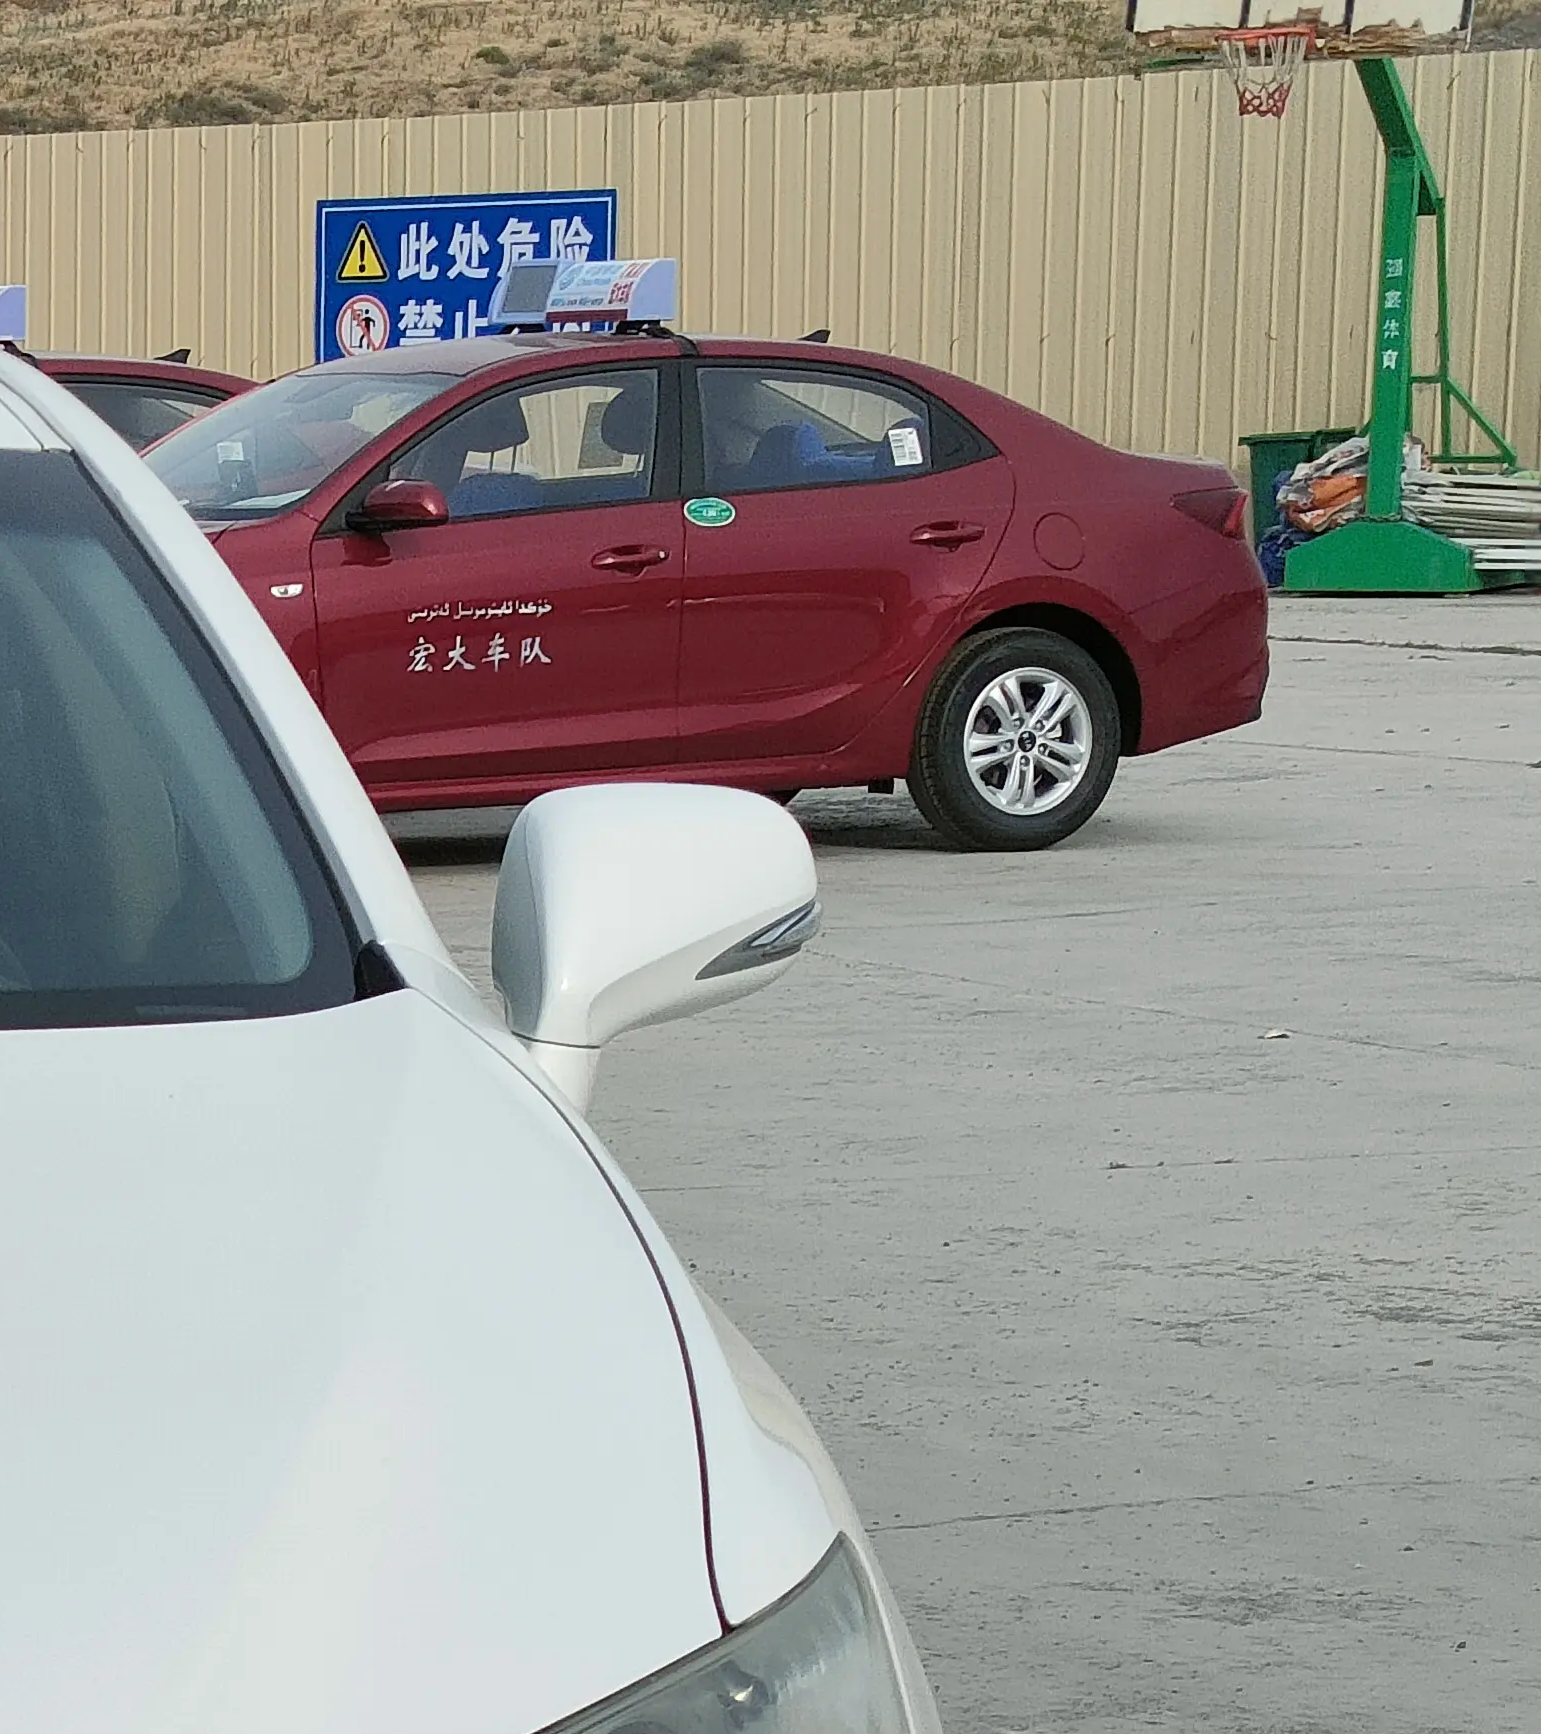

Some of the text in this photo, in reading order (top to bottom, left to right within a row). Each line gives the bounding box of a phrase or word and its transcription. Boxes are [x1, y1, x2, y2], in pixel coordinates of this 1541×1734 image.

[398, 216, 594, 281] 此处危险
[407, 632, 552, 673] 宏大车队
